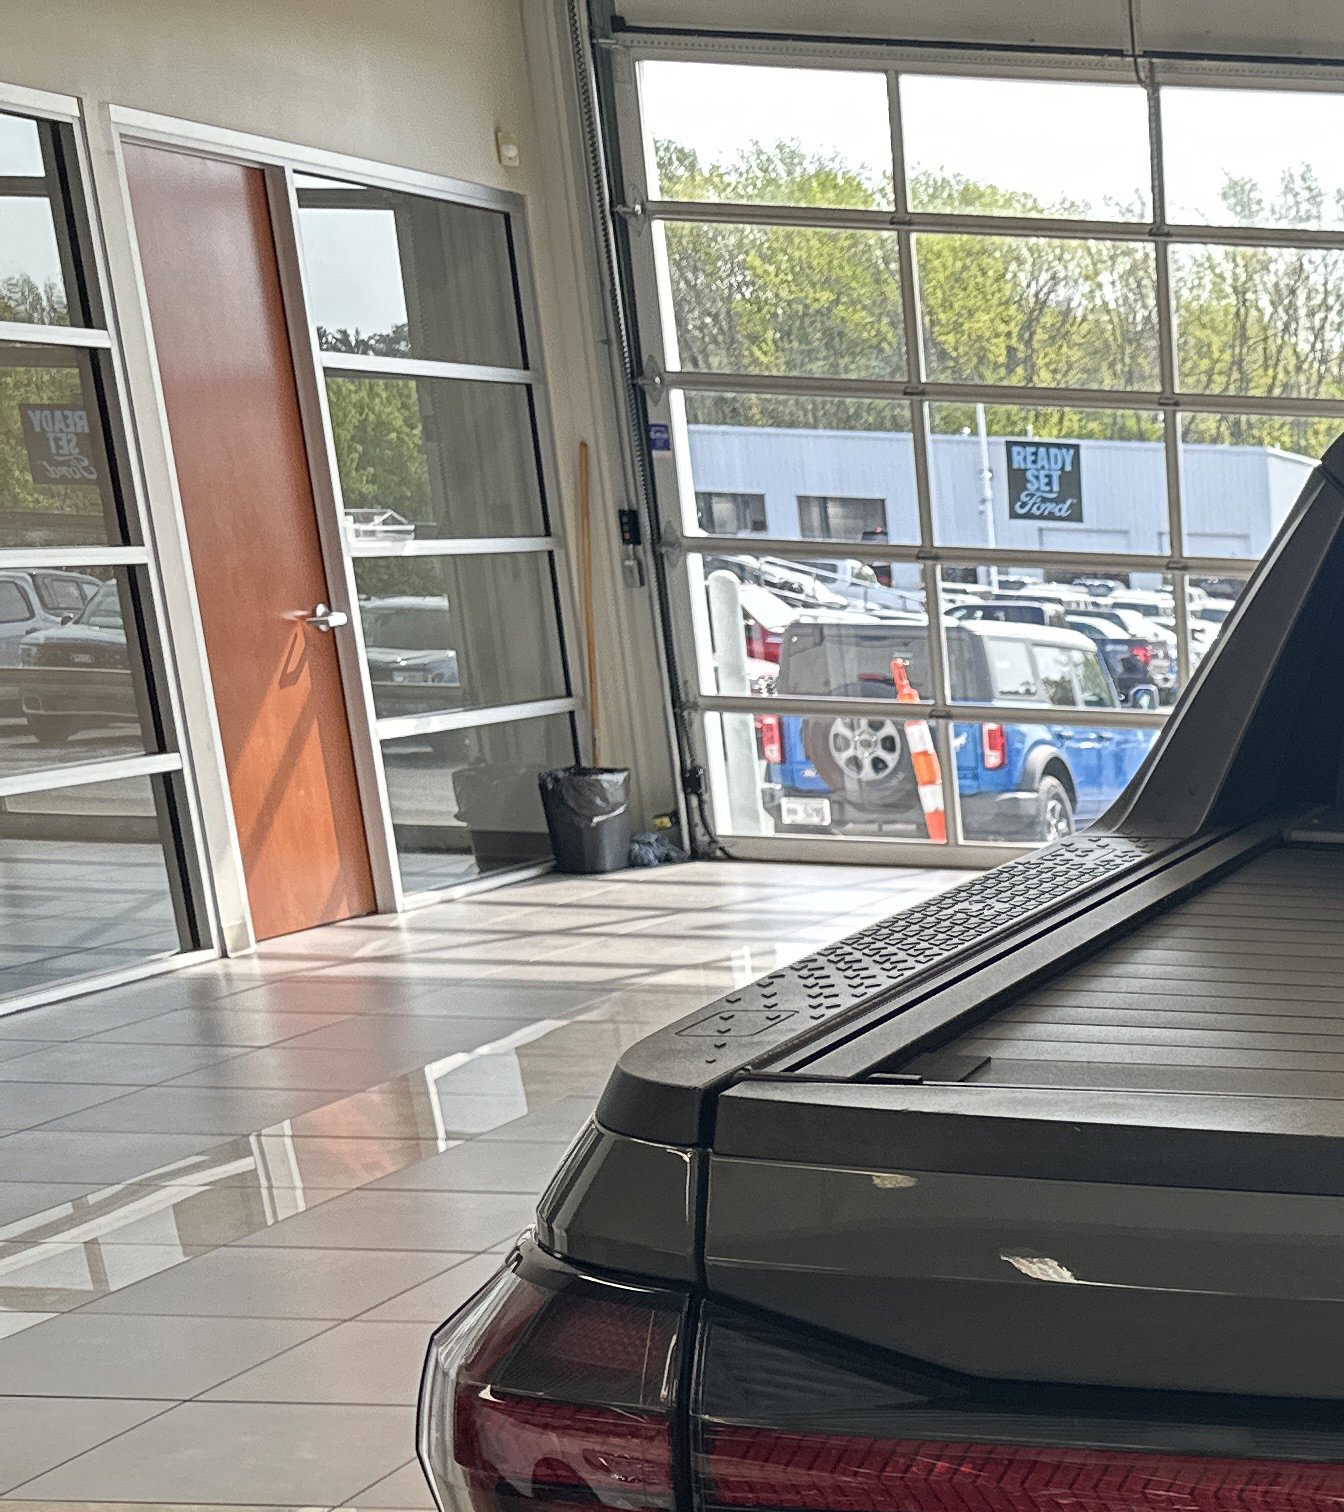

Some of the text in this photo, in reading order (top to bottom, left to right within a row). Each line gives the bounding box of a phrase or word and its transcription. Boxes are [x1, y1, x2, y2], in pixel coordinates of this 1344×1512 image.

[1011, 446, 1074, 471] READY
[1025, 469, 1061, 492] SET
[1014, 491, 1077, 517] Ford
